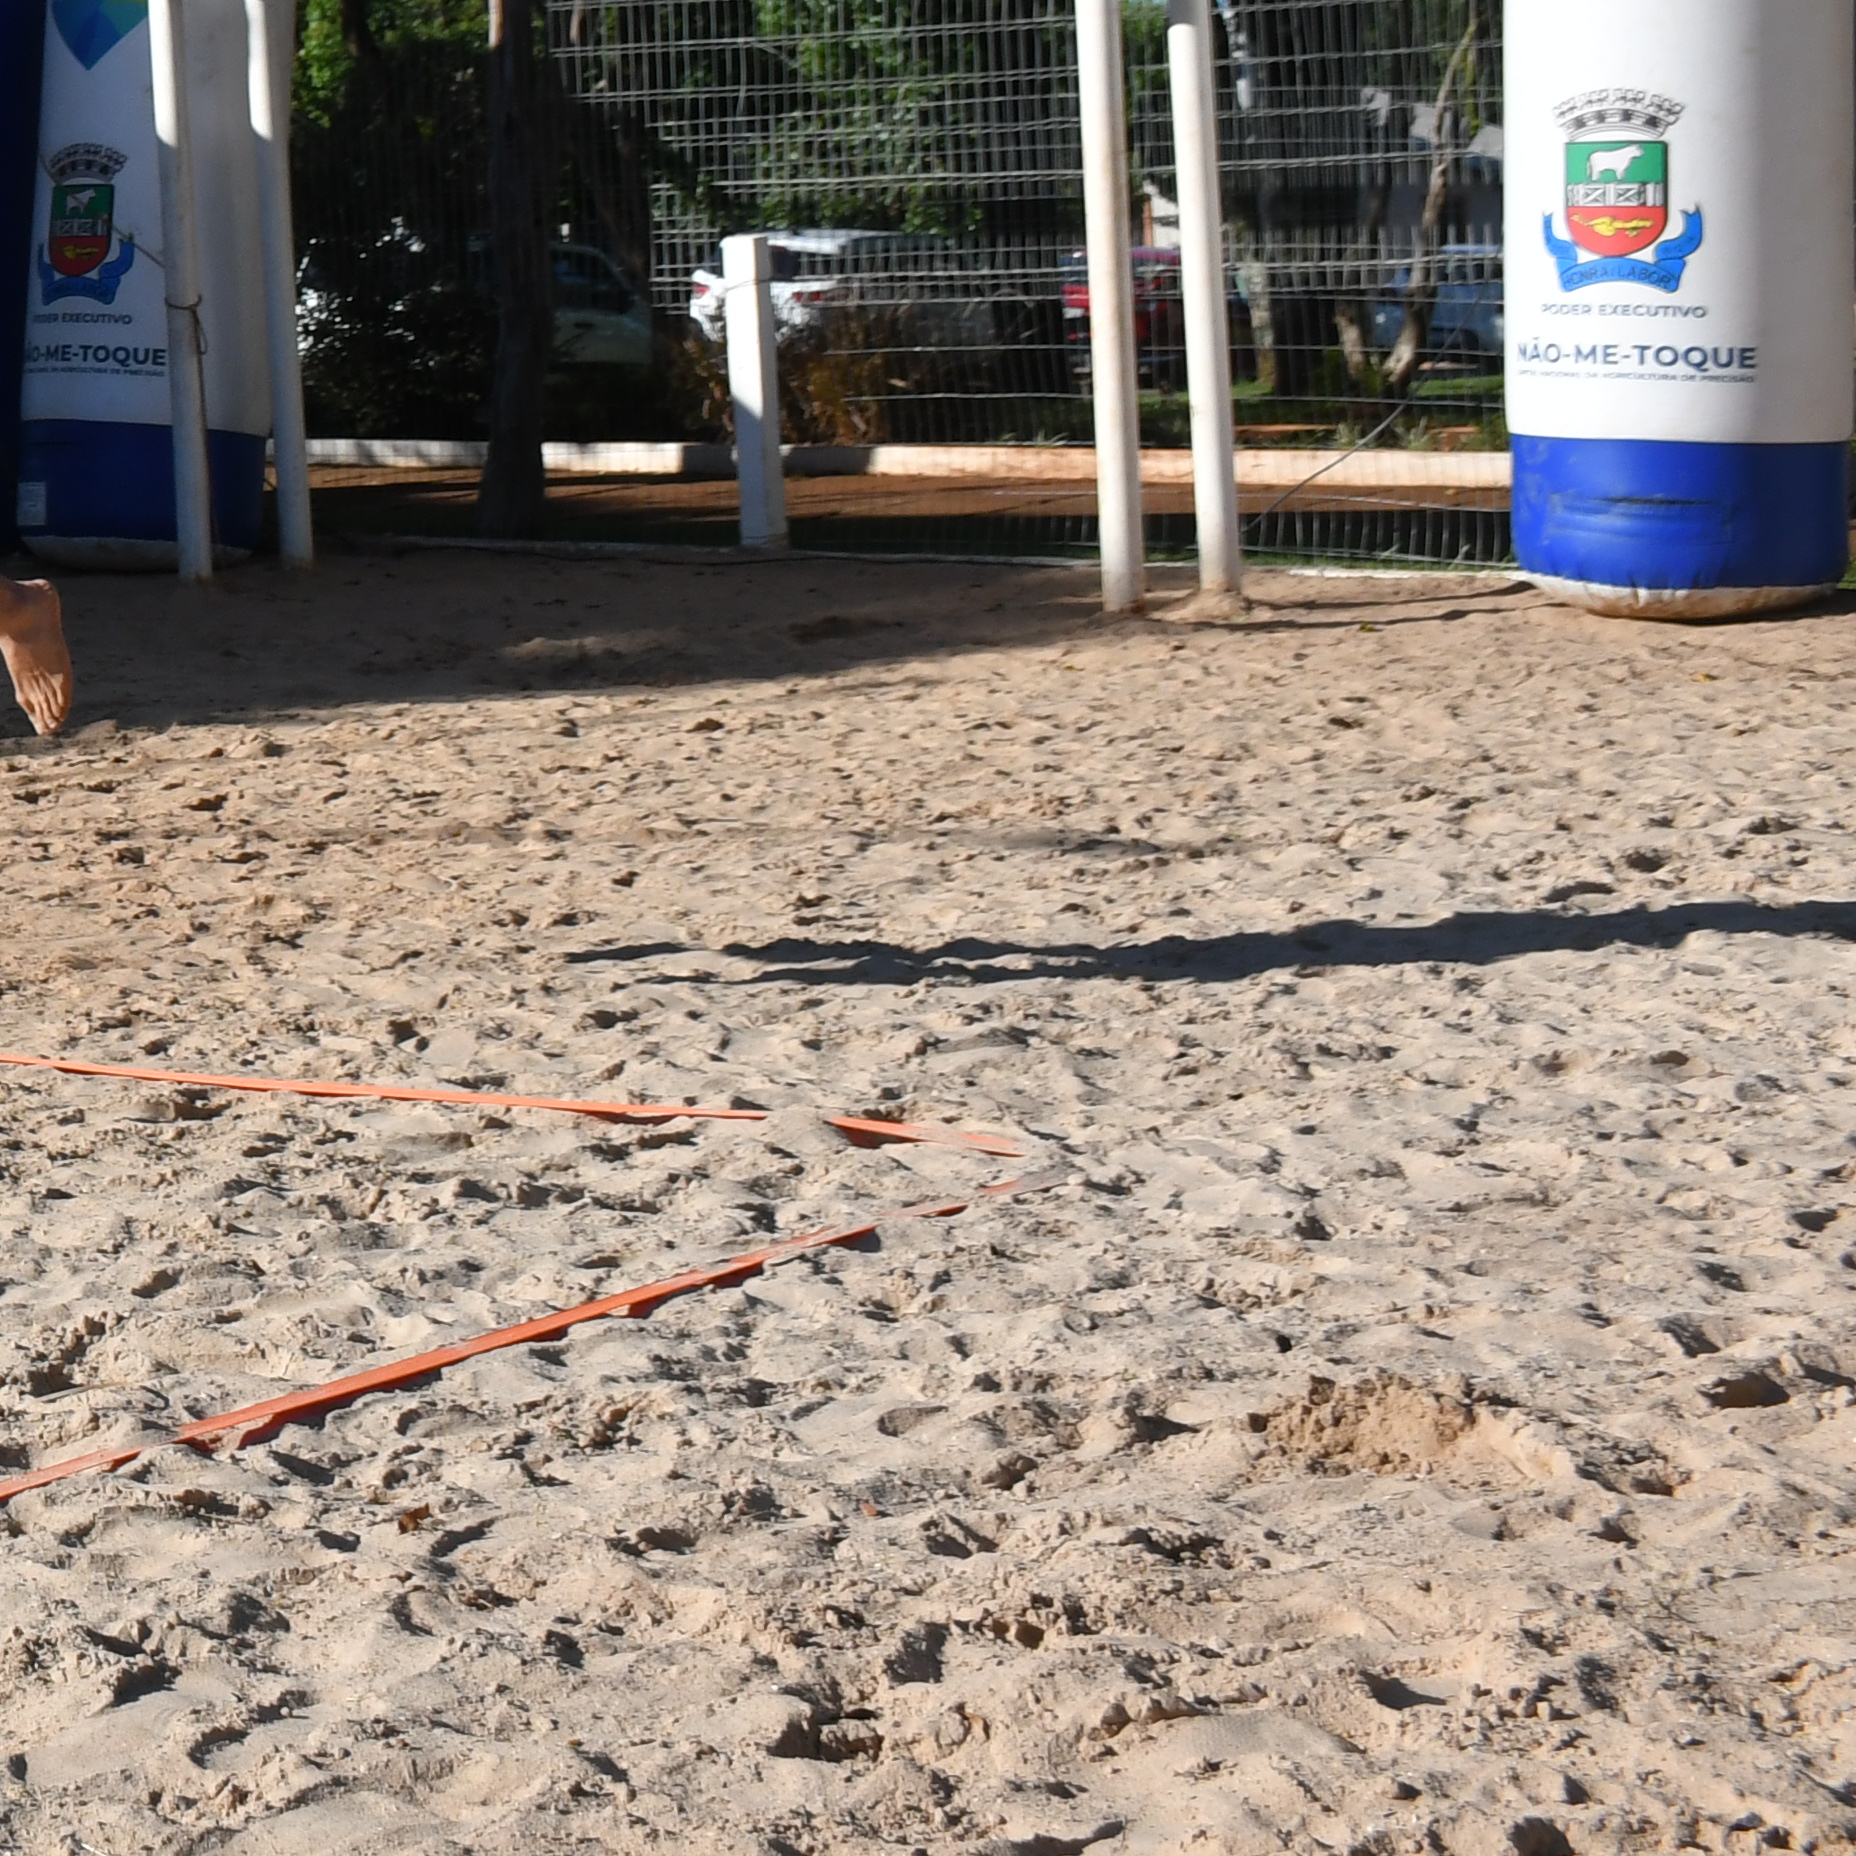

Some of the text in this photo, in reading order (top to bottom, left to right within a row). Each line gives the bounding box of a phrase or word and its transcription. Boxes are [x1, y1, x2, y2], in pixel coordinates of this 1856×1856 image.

[1616, 266, 1671, 290] LABOR
[62, 312, 132, 325] EXECUTIVO
[1542, 303, 1708, 319] PODER EXECUTIVO
[1517, 336, 1758, 373] NÃO-ME-TOQUE
[1679, 374, 1696, 382] DE
